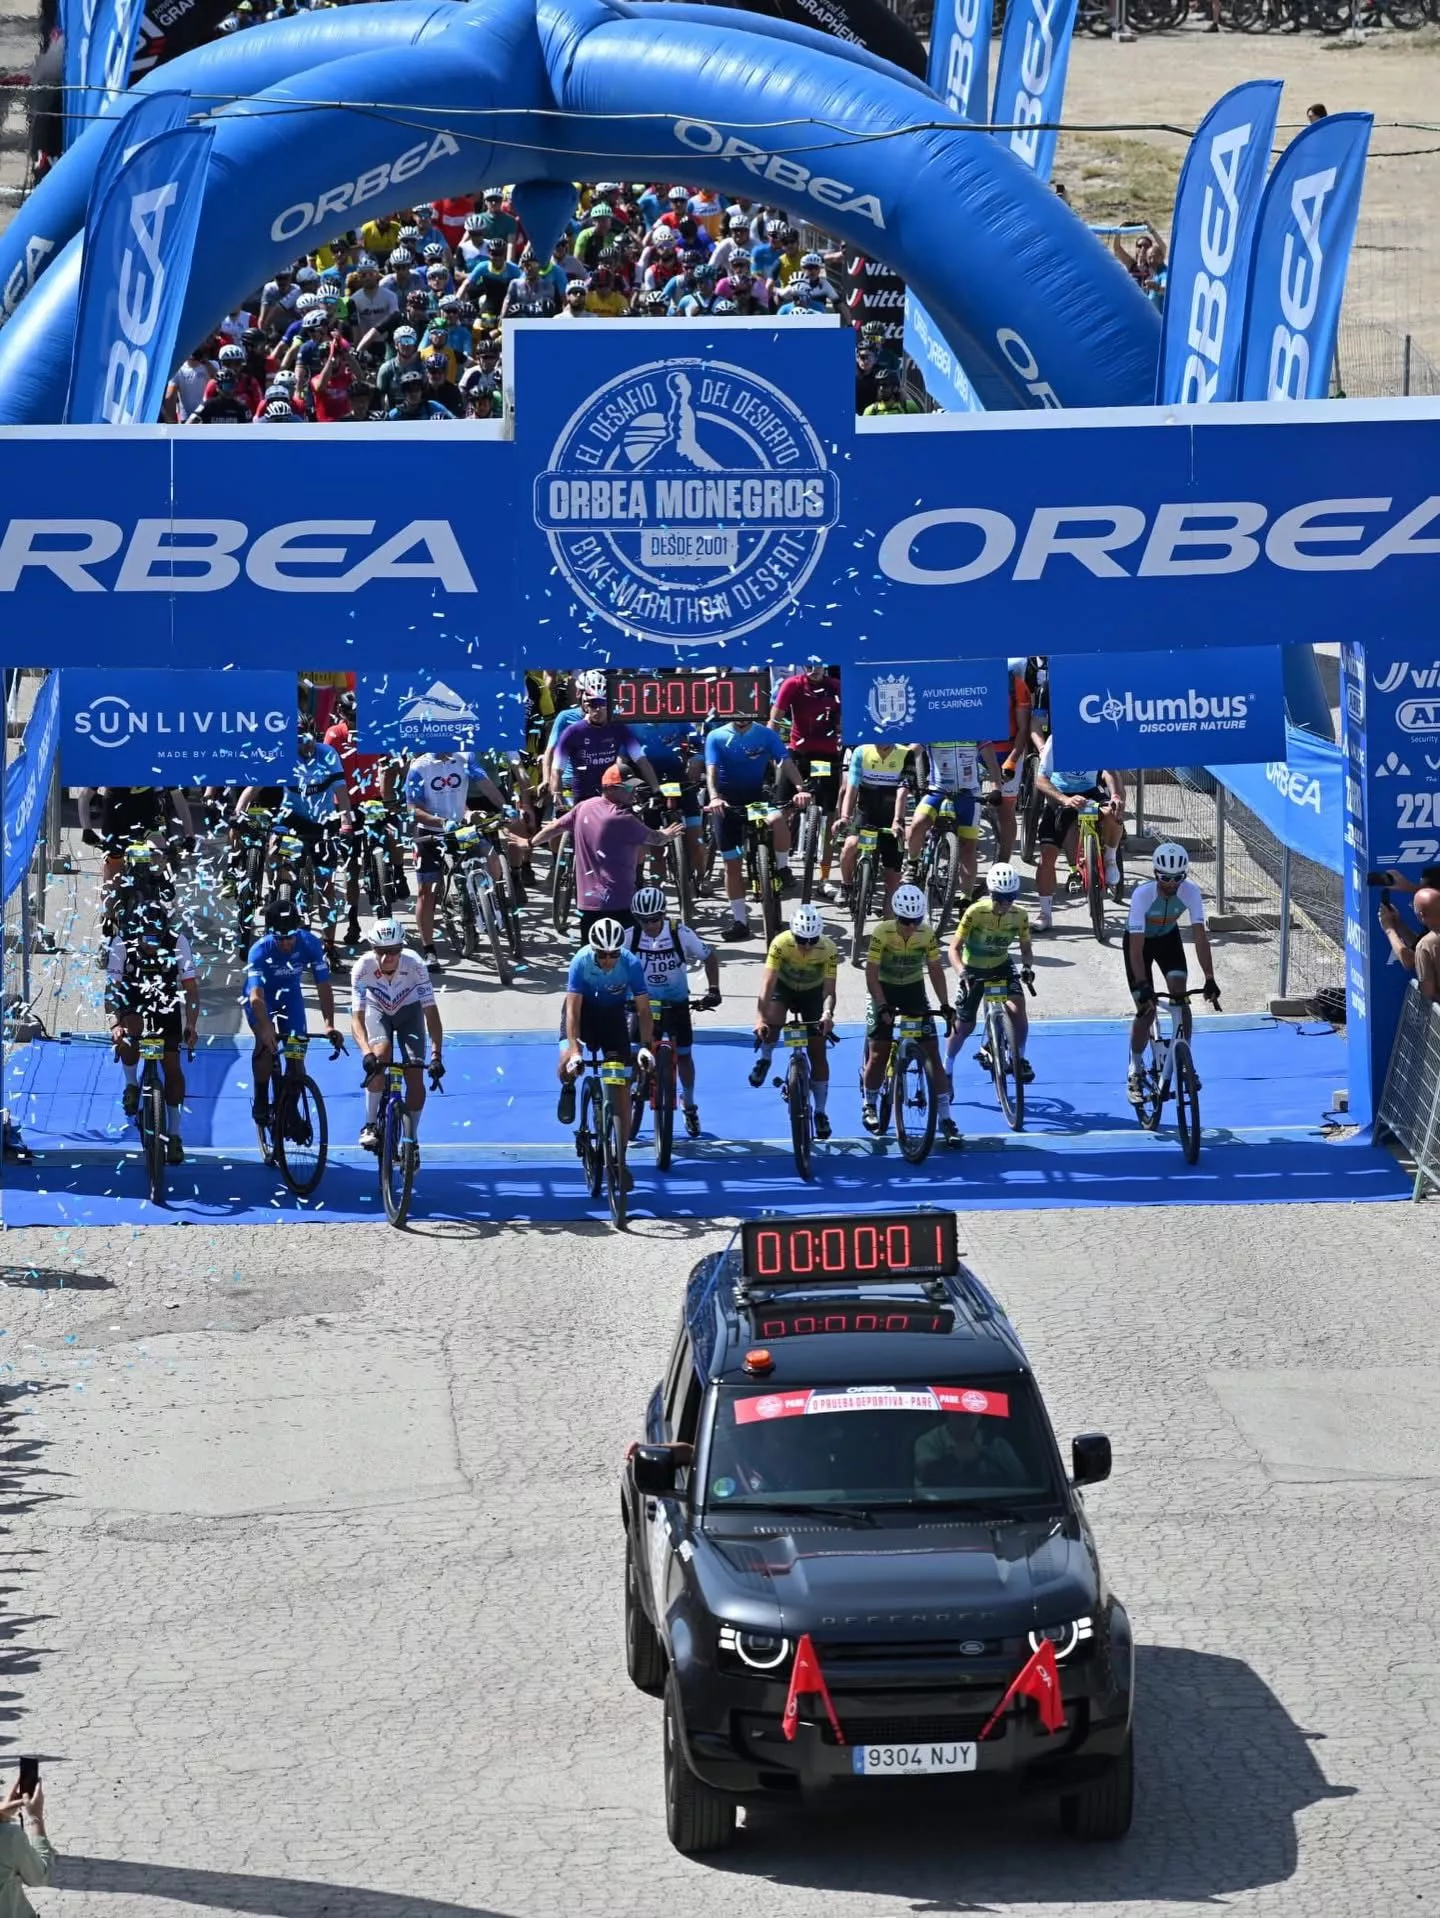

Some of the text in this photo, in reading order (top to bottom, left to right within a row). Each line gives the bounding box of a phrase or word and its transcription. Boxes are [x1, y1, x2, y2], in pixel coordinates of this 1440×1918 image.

[271, 129, 460, 243] ORBEA
[673, 118, 887, 230] ORBEA
[0, 235, 55, 326] EA
[102, 181, 178, 424] BEA
[575, 382, 658, 466] EL DESAFIO
[700, 378, 800, 466] DEL DESIERTO
[549, 479, 825, 520] ORBEA MONEGROS
[0, 518, 479, 593] RBEA
[651, 536, 729, 556] DESDE 2001
[570, 533, 806, 624] BIKE MARATHON DESERT
[618, 681, 760, 716] 00:00:01
[922, 686, 988, 698] AYUNTAMIENTO
[928, 698, 983, 710] DE SARIÑENA
[1078, 688, 1248, 725] Columbus
[74, 711, 288, 734] SUNLIVING
[399, 722, 481, 734] Los Monegros
[1139, 719, 1247, 733] DISCOVER NATURE
[1410, 735, 1439, 744] Security
[157, 750, 189, 759] MADE
[193, 750, 206, 759] BY
[757, 1225, 944, 1274] 00:00:01
[868, 1745, 971, 1767] 9304 NJY
